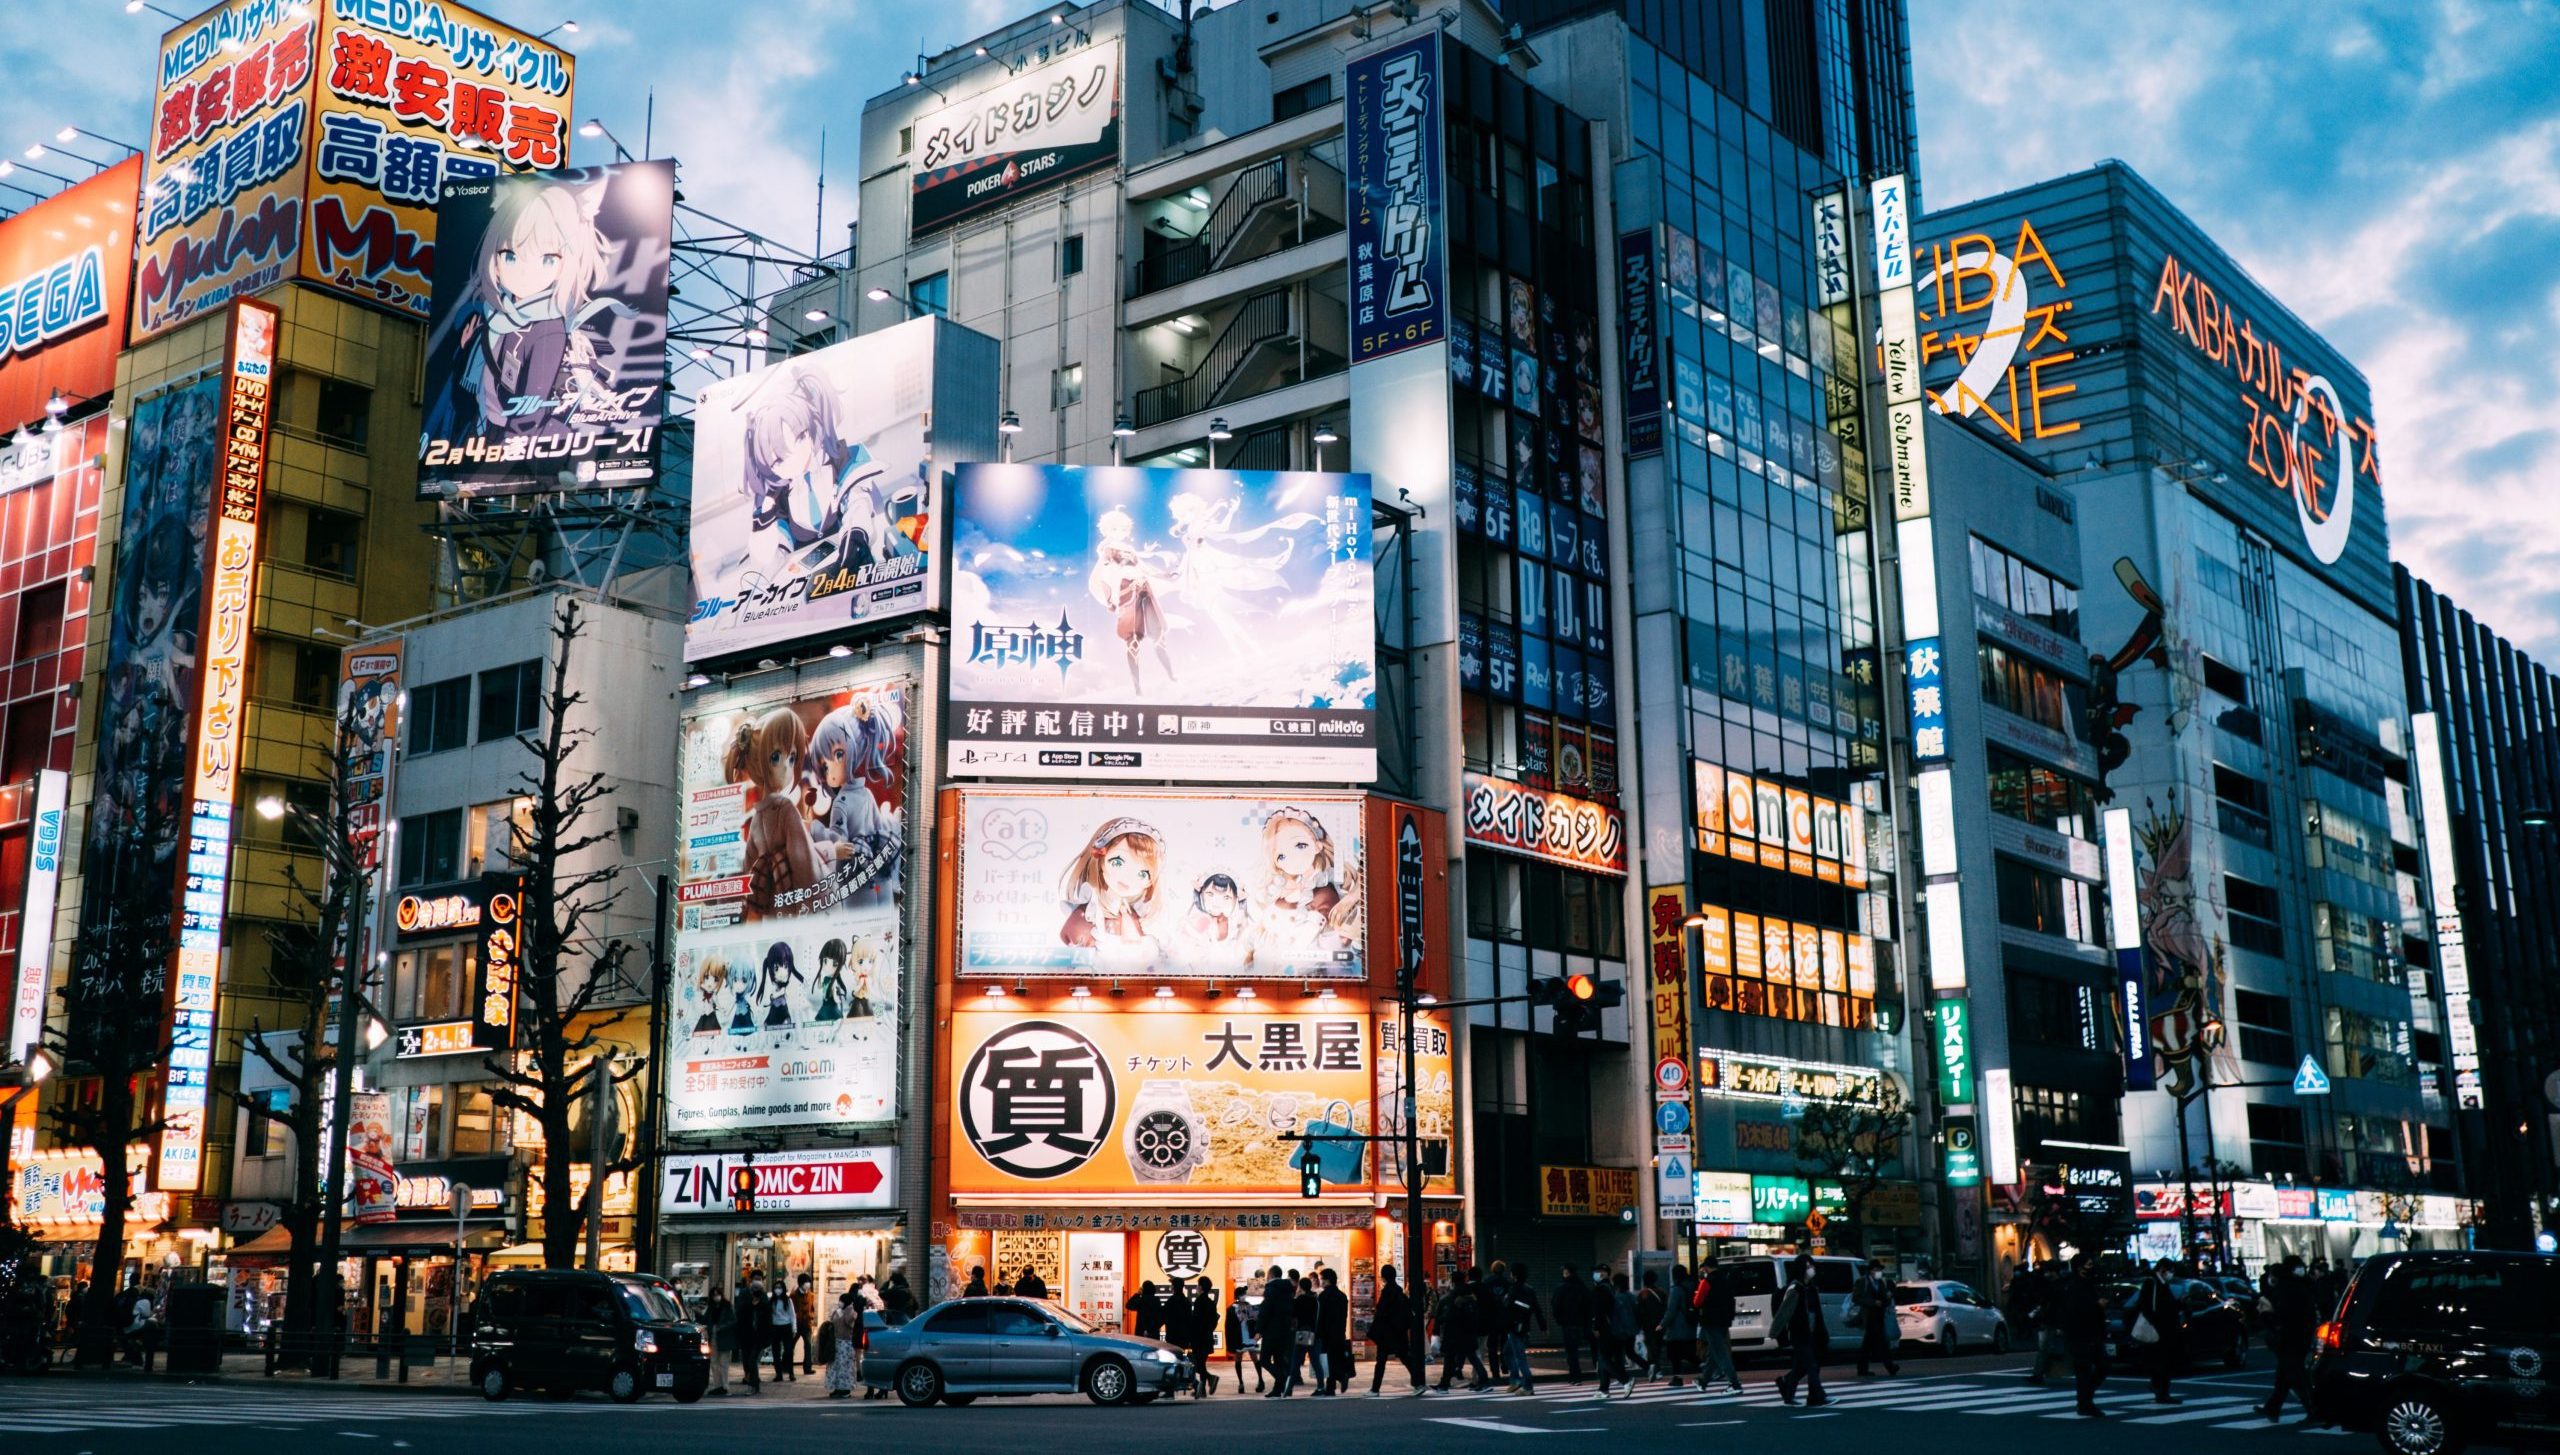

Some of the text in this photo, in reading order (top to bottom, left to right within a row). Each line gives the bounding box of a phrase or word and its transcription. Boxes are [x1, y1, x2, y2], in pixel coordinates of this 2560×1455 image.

[158, 22, 313, 155] 激安販売
[334, 29, 561, 168] 激安販売
[924, 65, 1106, 169] メイドカジノ
[1358, 83, 1370, 217] トレーディングカードゲーム
[148, 101, 303, 242] 高額買取
[456, 184, 490, 197] Yostar
[967, 173, 1001, 198] POKER
[1881, 187, 1904, 278] スーパービル
[141, 196, 299, 327] Mulan
[1916, 219, 2066, 318] IBA
[336, 275, 412, 304] ムーラン
[1358, 243, 1374, 325] 秋葉原店
[0, 248, 104, 352] SEGA
[195, 285, 230, 312] AKIBA
[237, 360, 268, 375] あなたの
[1889, 339, 1907, 396] Yellow
[236, 378, 266, 396] DVD
[1480, 364, 1506, 398] 7F
[232, 410, 263, 428] ゲーム
[236, 426, 257, 442] CD
[229, 440, 260, 458] アイドル
[424, 427, 653, 465] 2月4日遂にリリース!
[227, 456, 258, 473] アニメ
[1894, 412, 1916, 508] Submarine
[2242, 395, 2330, 522] ZONE
[226, 488, 255, 504] ホビー
[1485, 507, 1511, 541] 6F
[810, 553, 921, 598] 2月4日配信開始!
[743, 602, 799, 623] BlueArchive
[967, 606, 1084, 690] 原神
[1490, 659, 1516, 692] 5F
[1724, 653, 1802, 715] 秋葉館
[1910, 647, 1945, 759] 秋葉館
[966, 708, 1146, 737] 好評配信中!
[1187, 718, 1365, 735] 原神 検索 miHoYo
[1863, 719, 1881, 740] 5F
[983, 752, 1028, 763] PS4
[1051, 753, 1079, 761] App Store
[1104, 754, 1121, 763] Google
[1123, 755, 1136, 764] Play
[193, 800, 209, 816] 6F
[690, 811, 719, 827] ココア
[998, 817, 1030, 840] at
[1470, 786, 1621, 862] メイドカジノ
[36, 810, 60, 872] SEGA
[190, 838, 206, 852] 5F
[193, 861, 224, 875] DVD
[984, 869, 1045, 884] バーチャル
[186, 876, 202, 890] 4F
[183, 913, 199, 927] 3F
[20, 966, 42, 1019] 3号館
[181, 973, 212, 990] 買取
[175, 1010, 189, 1024] 1F
[2125, 980, 2143, 1060] GALLERIA
[1127, 1021, 1363, 1073] チケット 大黒屋
[1941, 1005, 1965, 1098] リバティー
[168, 1068, 188, 1084] B1F
[781, 1058, 836, 1076] amiami
[1663, 1065, 1680, 1080] 40
[677, 1107, 706, 1119] Figures,
[742, 1104, 766, 1115] Anime
[768, 1102, 792, 1115] goods
[793, 1101, 809, 1112] and
[810, 1102, 832, 1111] more
[977, 1046, 1101, 1158] 質
[1664, 1109, 1677, 1132] P
[1956, 1132, 1968, 1147] P
[164, 1148, 198, 1161] AKIBA
[763, 1153, 786, 1164] Support
[787, 1153, 795, 1162] for
[796, 1151, 827, 1162] Magazine
[669, 1158, 723, 1209] ZIN
[809, 1165, 843, 1192] ZIN
[1593, 1170, 1633, 1194] TAX FREE
[727, 1198, 791, 1209] Aabara
[1754, 1186, 1809, 1210] リバティー
[230, 1207, 275, 1228] ラーメン
[960, 1212, 1373, 1229] 高価買取 無料査定
[1163, 1234, 1203, 1273] 質
[1081, 1261, 1113, 1271] 大黒屋
[2417, 1343, 2444, 1353] TAXI
